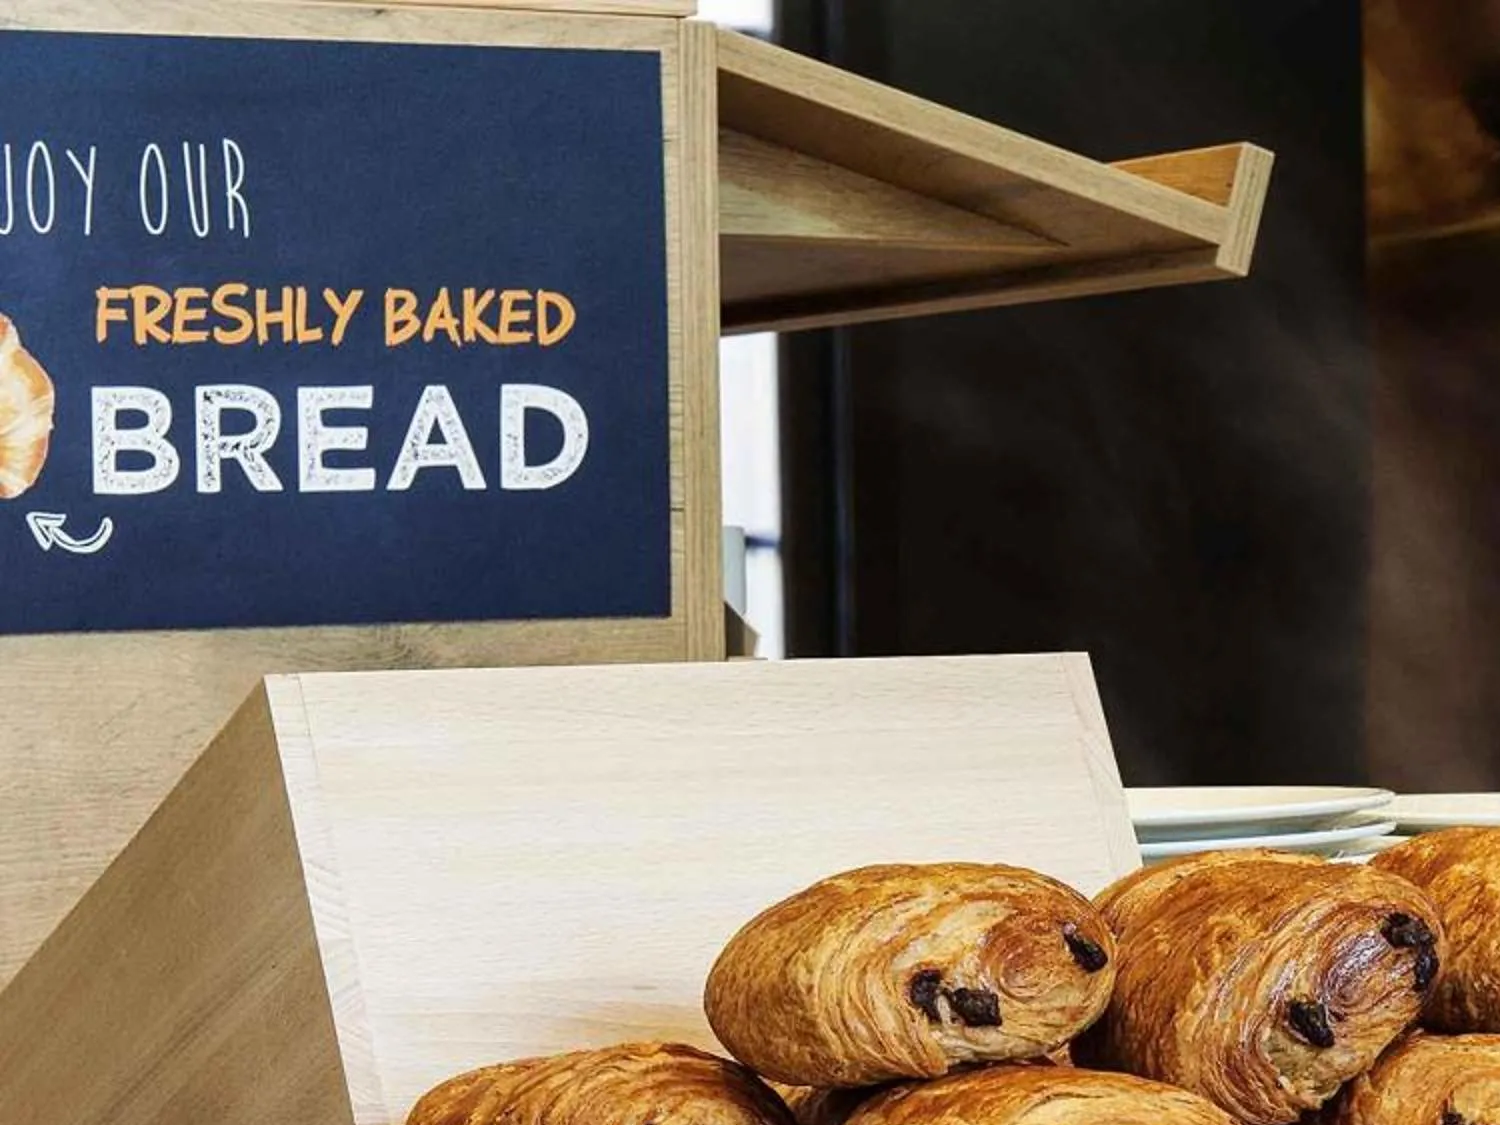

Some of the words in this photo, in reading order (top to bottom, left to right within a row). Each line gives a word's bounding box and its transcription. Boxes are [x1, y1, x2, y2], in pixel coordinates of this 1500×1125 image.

[139, 138, 250, 238] OUR
[95, 284, 363, 347] FRESHLY
[384, 287, 577, 347] BAKED
[91, 384, 589, 495] BREAD
